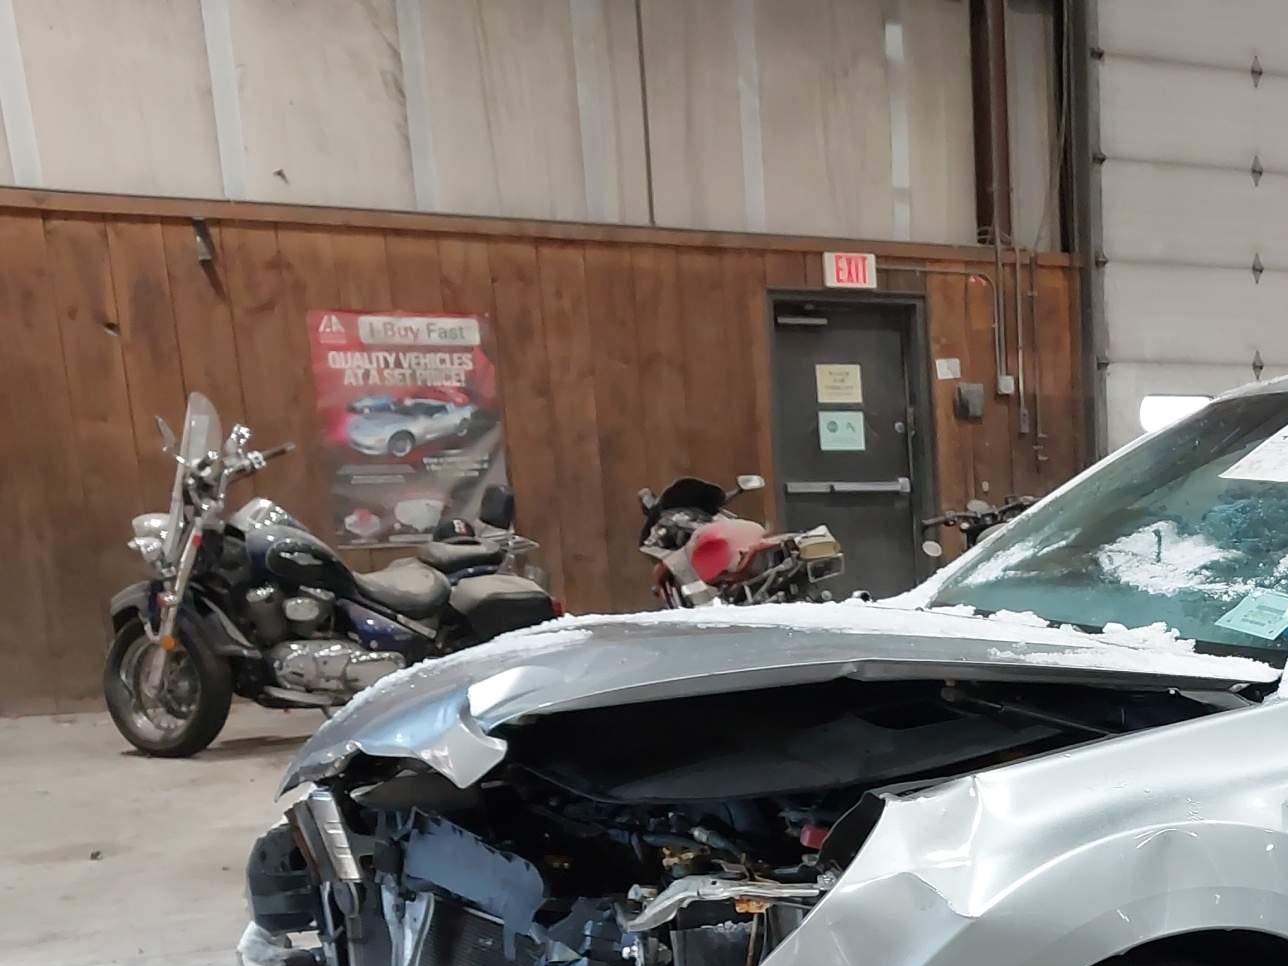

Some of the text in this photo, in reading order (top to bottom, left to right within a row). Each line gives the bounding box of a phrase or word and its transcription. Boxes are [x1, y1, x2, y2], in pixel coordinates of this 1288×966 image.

[834, 254, 868, 284] EXIT
[383, 321, 420, 341] Buy
[425, 322, 466, 341] Fast
[327, 351, 473, 371] QUALITY VEHICLES
[343, 369, 366, 386] AT
[368, 369, 381, 386] A
[383, 370, 413, 386] SET
